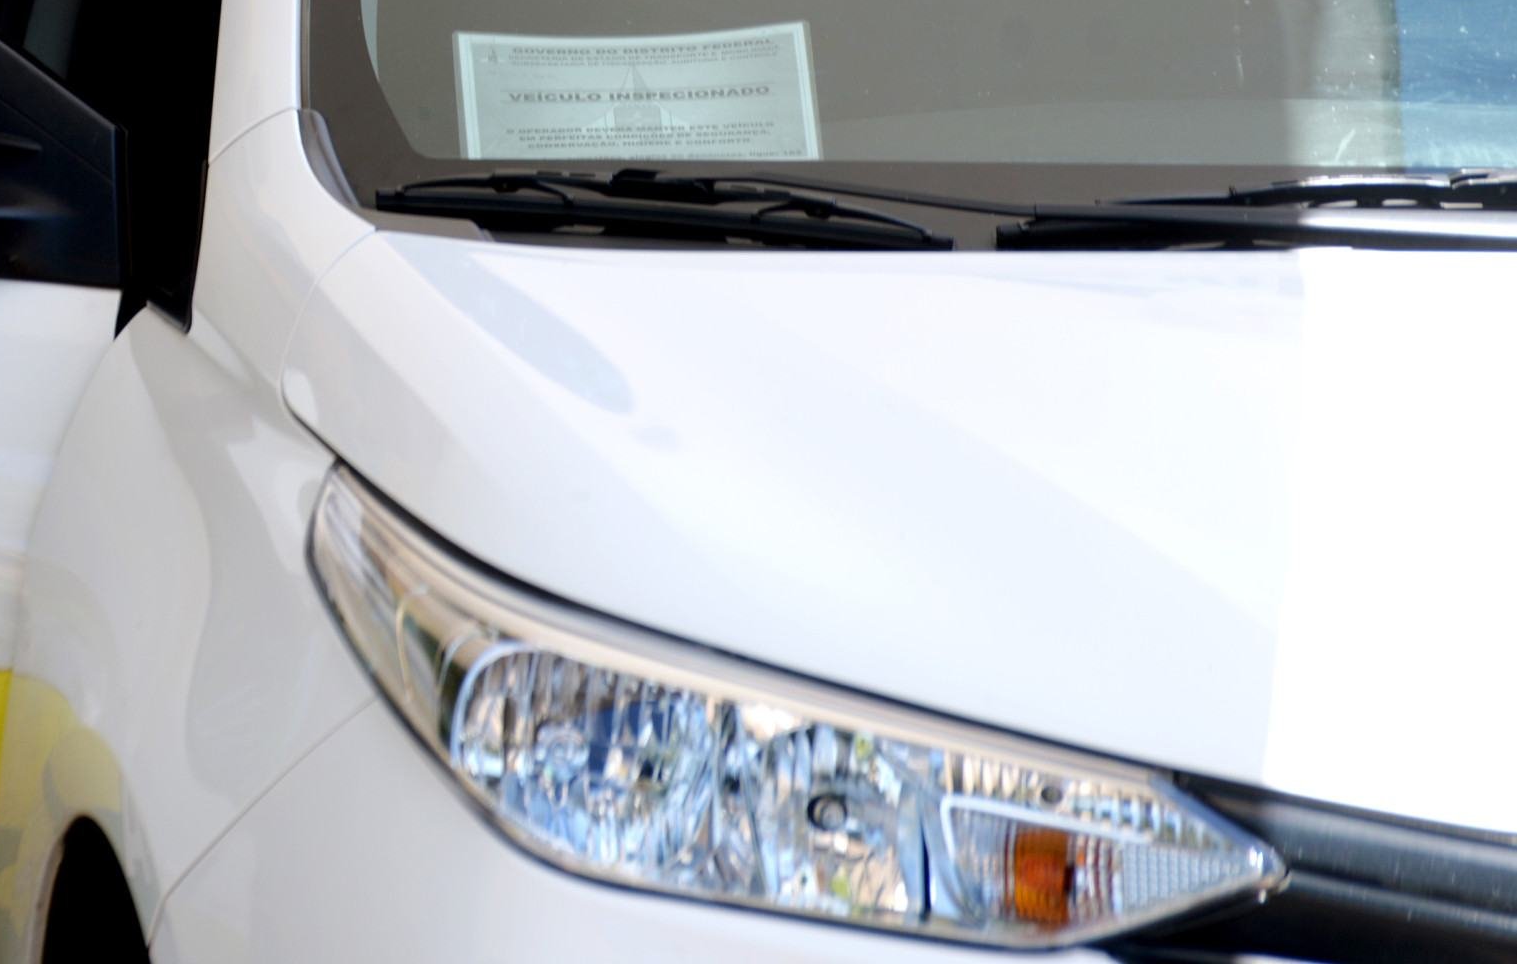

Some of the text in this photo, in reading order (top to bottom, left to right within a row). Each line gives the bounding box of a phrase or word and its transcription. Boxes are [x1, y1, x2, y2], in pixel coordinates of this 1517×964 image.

[512, 47, 591, 55] GOVERNO
[595, 47, 618, 55] DO
[622, 45, 697, 55] DISTRITO
[702, 39, 772, 51] FEDERAL
[509, 87, 770, 102] VEÍCULO INSPECIONADO
